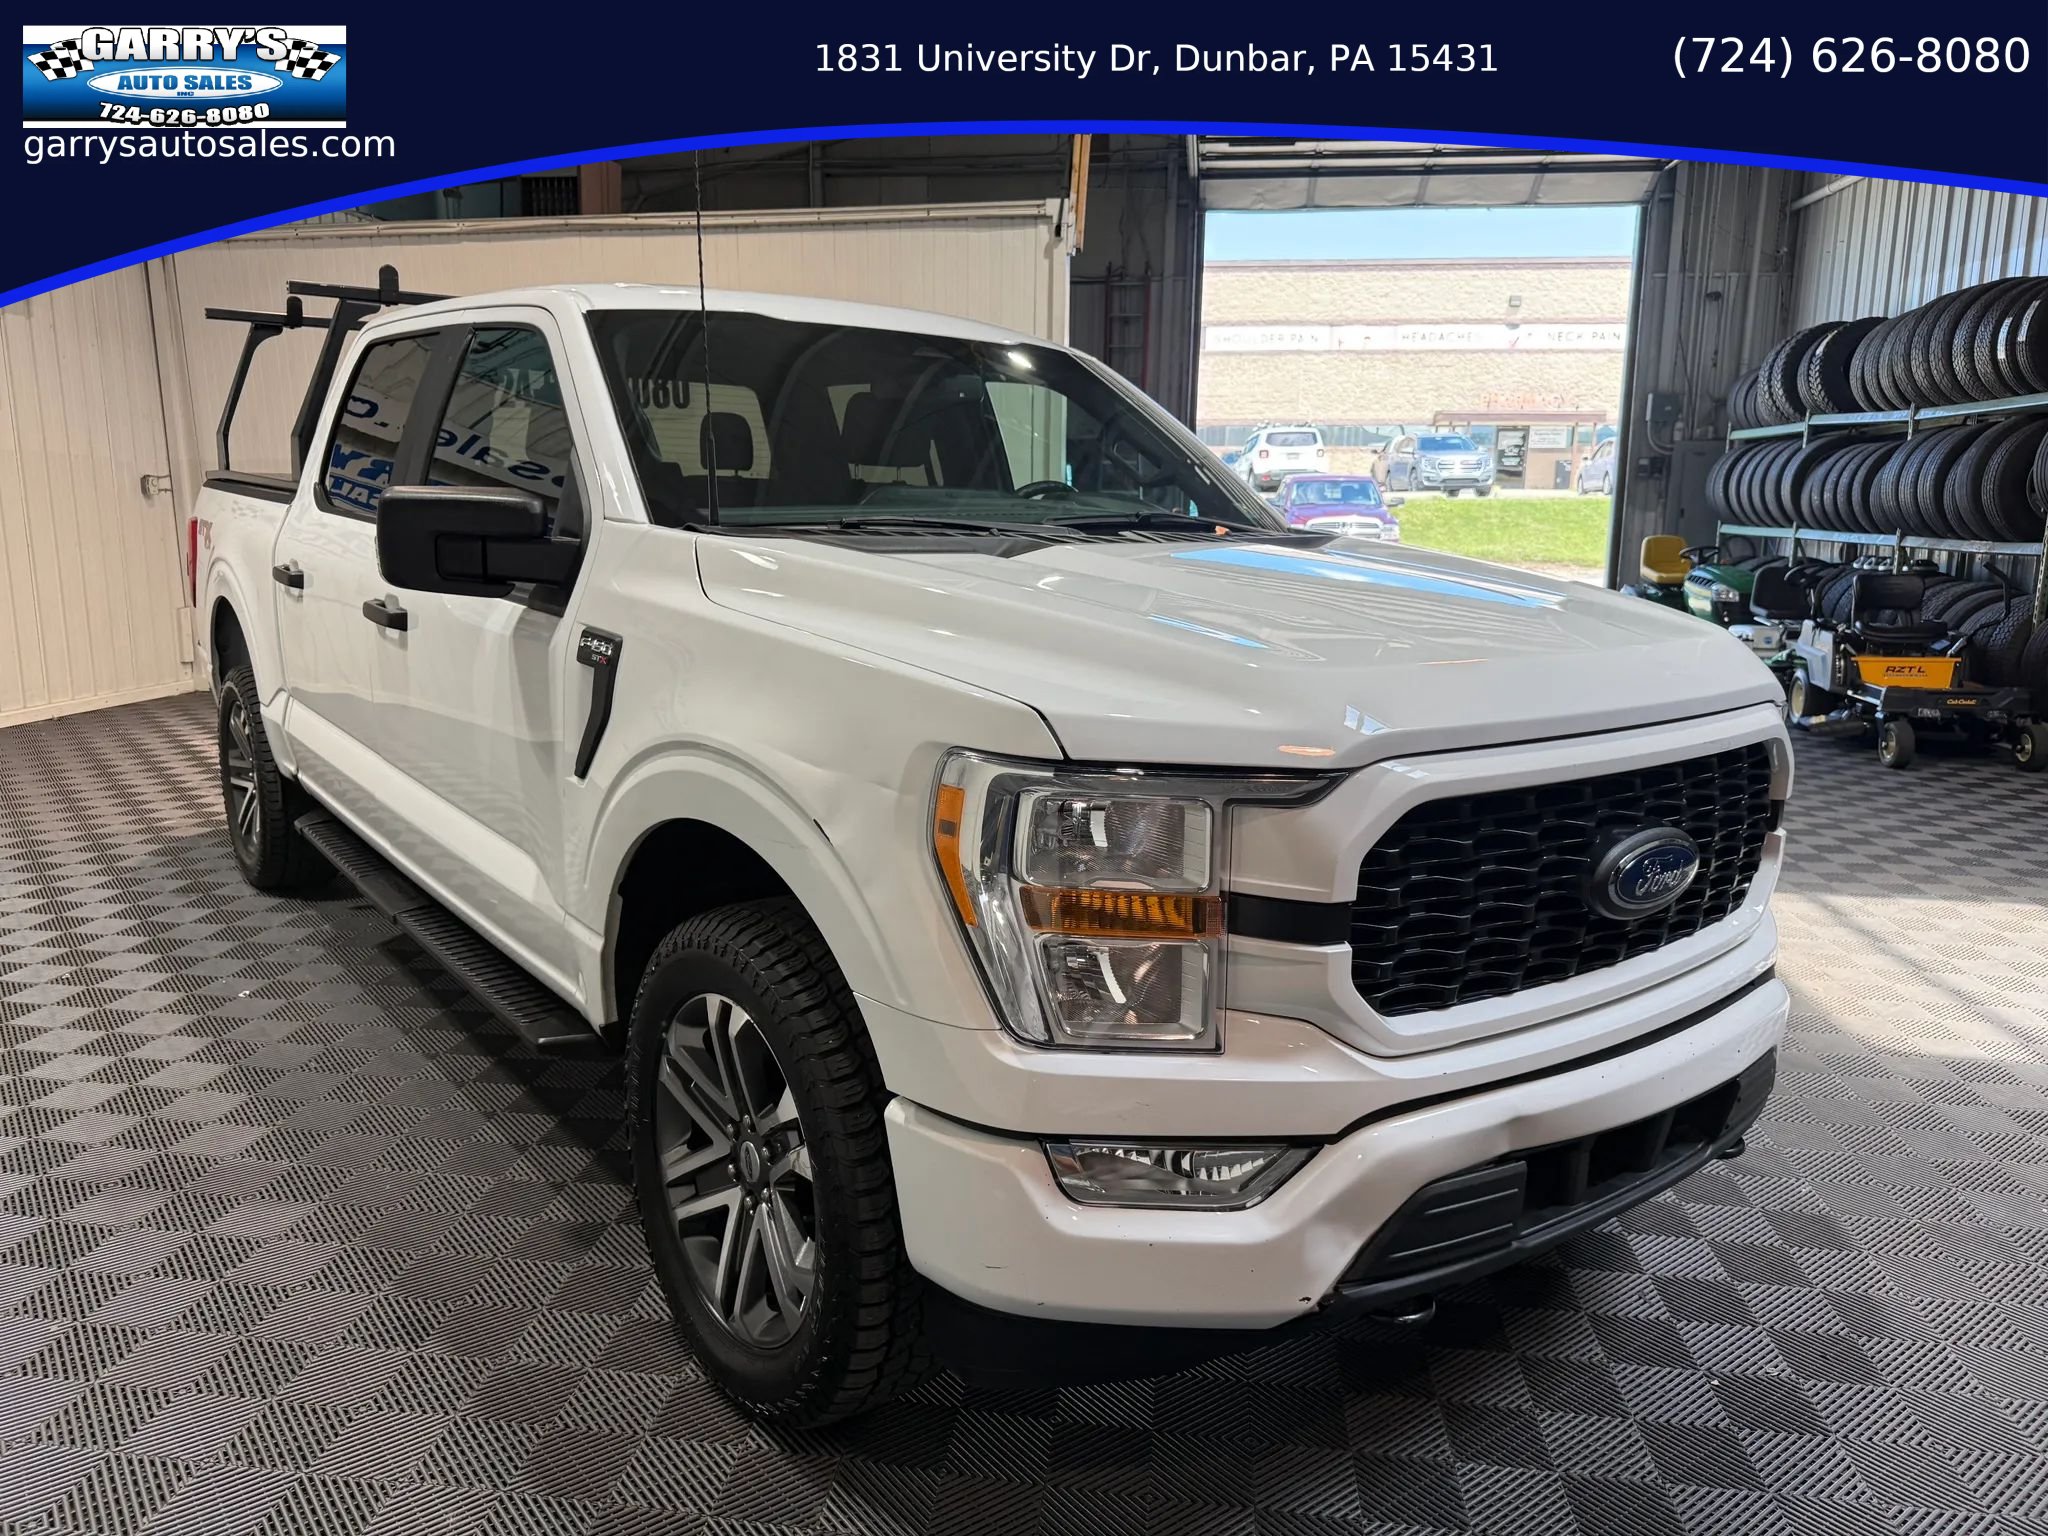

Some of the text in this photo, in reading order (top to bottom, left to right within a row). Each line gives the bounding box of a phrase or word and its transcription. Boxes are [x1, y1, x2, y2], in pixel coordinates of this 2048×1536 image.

[1548, 331, 1621, 343] NECK PAIN
[591, 653, 608, 665] STX
[1885, 665, 1917, 673] RZT
[1635, 854, 1685, 896] Ford
